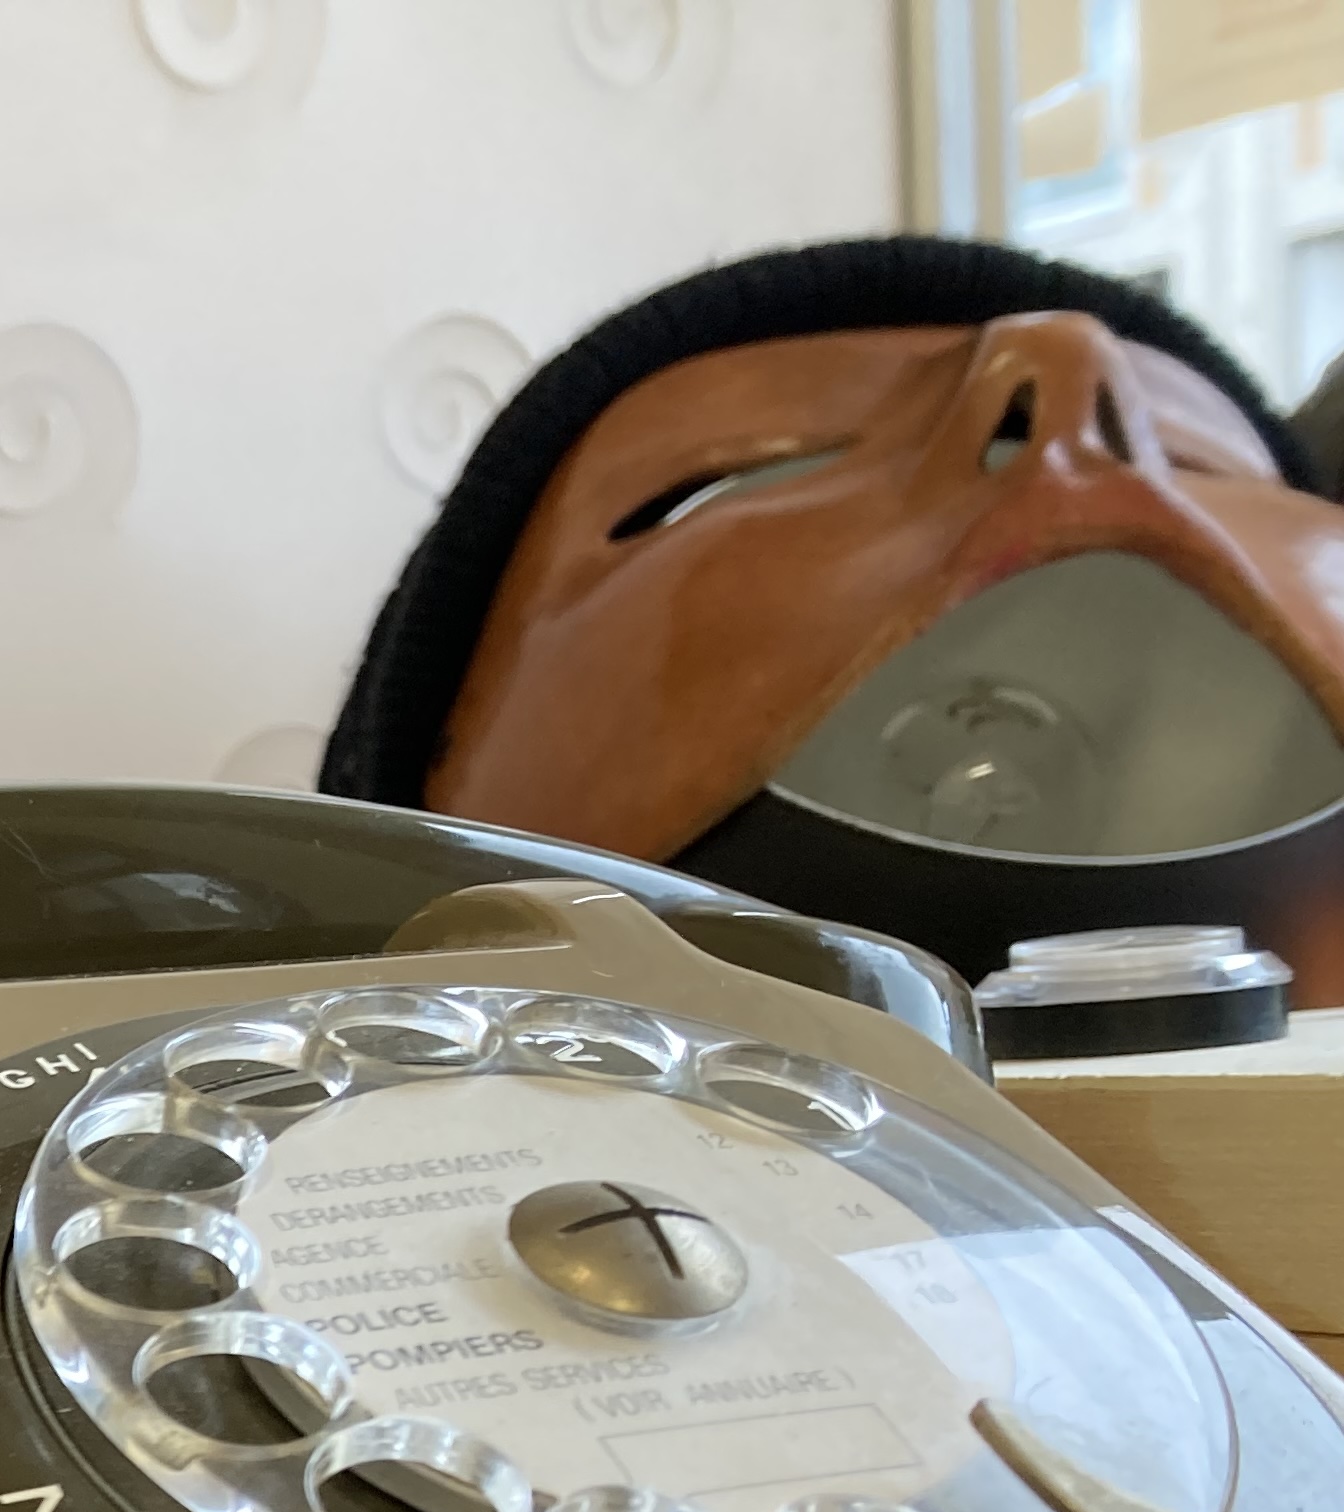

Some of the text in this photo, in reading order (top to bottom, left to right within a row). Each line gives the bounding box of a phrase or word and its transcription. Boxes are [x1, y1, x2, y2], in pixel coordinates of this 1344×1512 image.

[696, 1132, 734, 1150] 12
[284, 1148, 543, 1194] RENSEIGNEMENTS
[762, 1159, 799, 1176] 13
[269, 1185, 508, 1231] DERANGEMENTS
[836, 1203, 874, 1220] 14
[270, 1235, 390, 1268] AGENCE
[305, 1302, 448, 1335] POLICE
[345, 1330, 544, 1375] POMPIERS
[395, 1353, 671, 1410] AUTRES SERVICES
